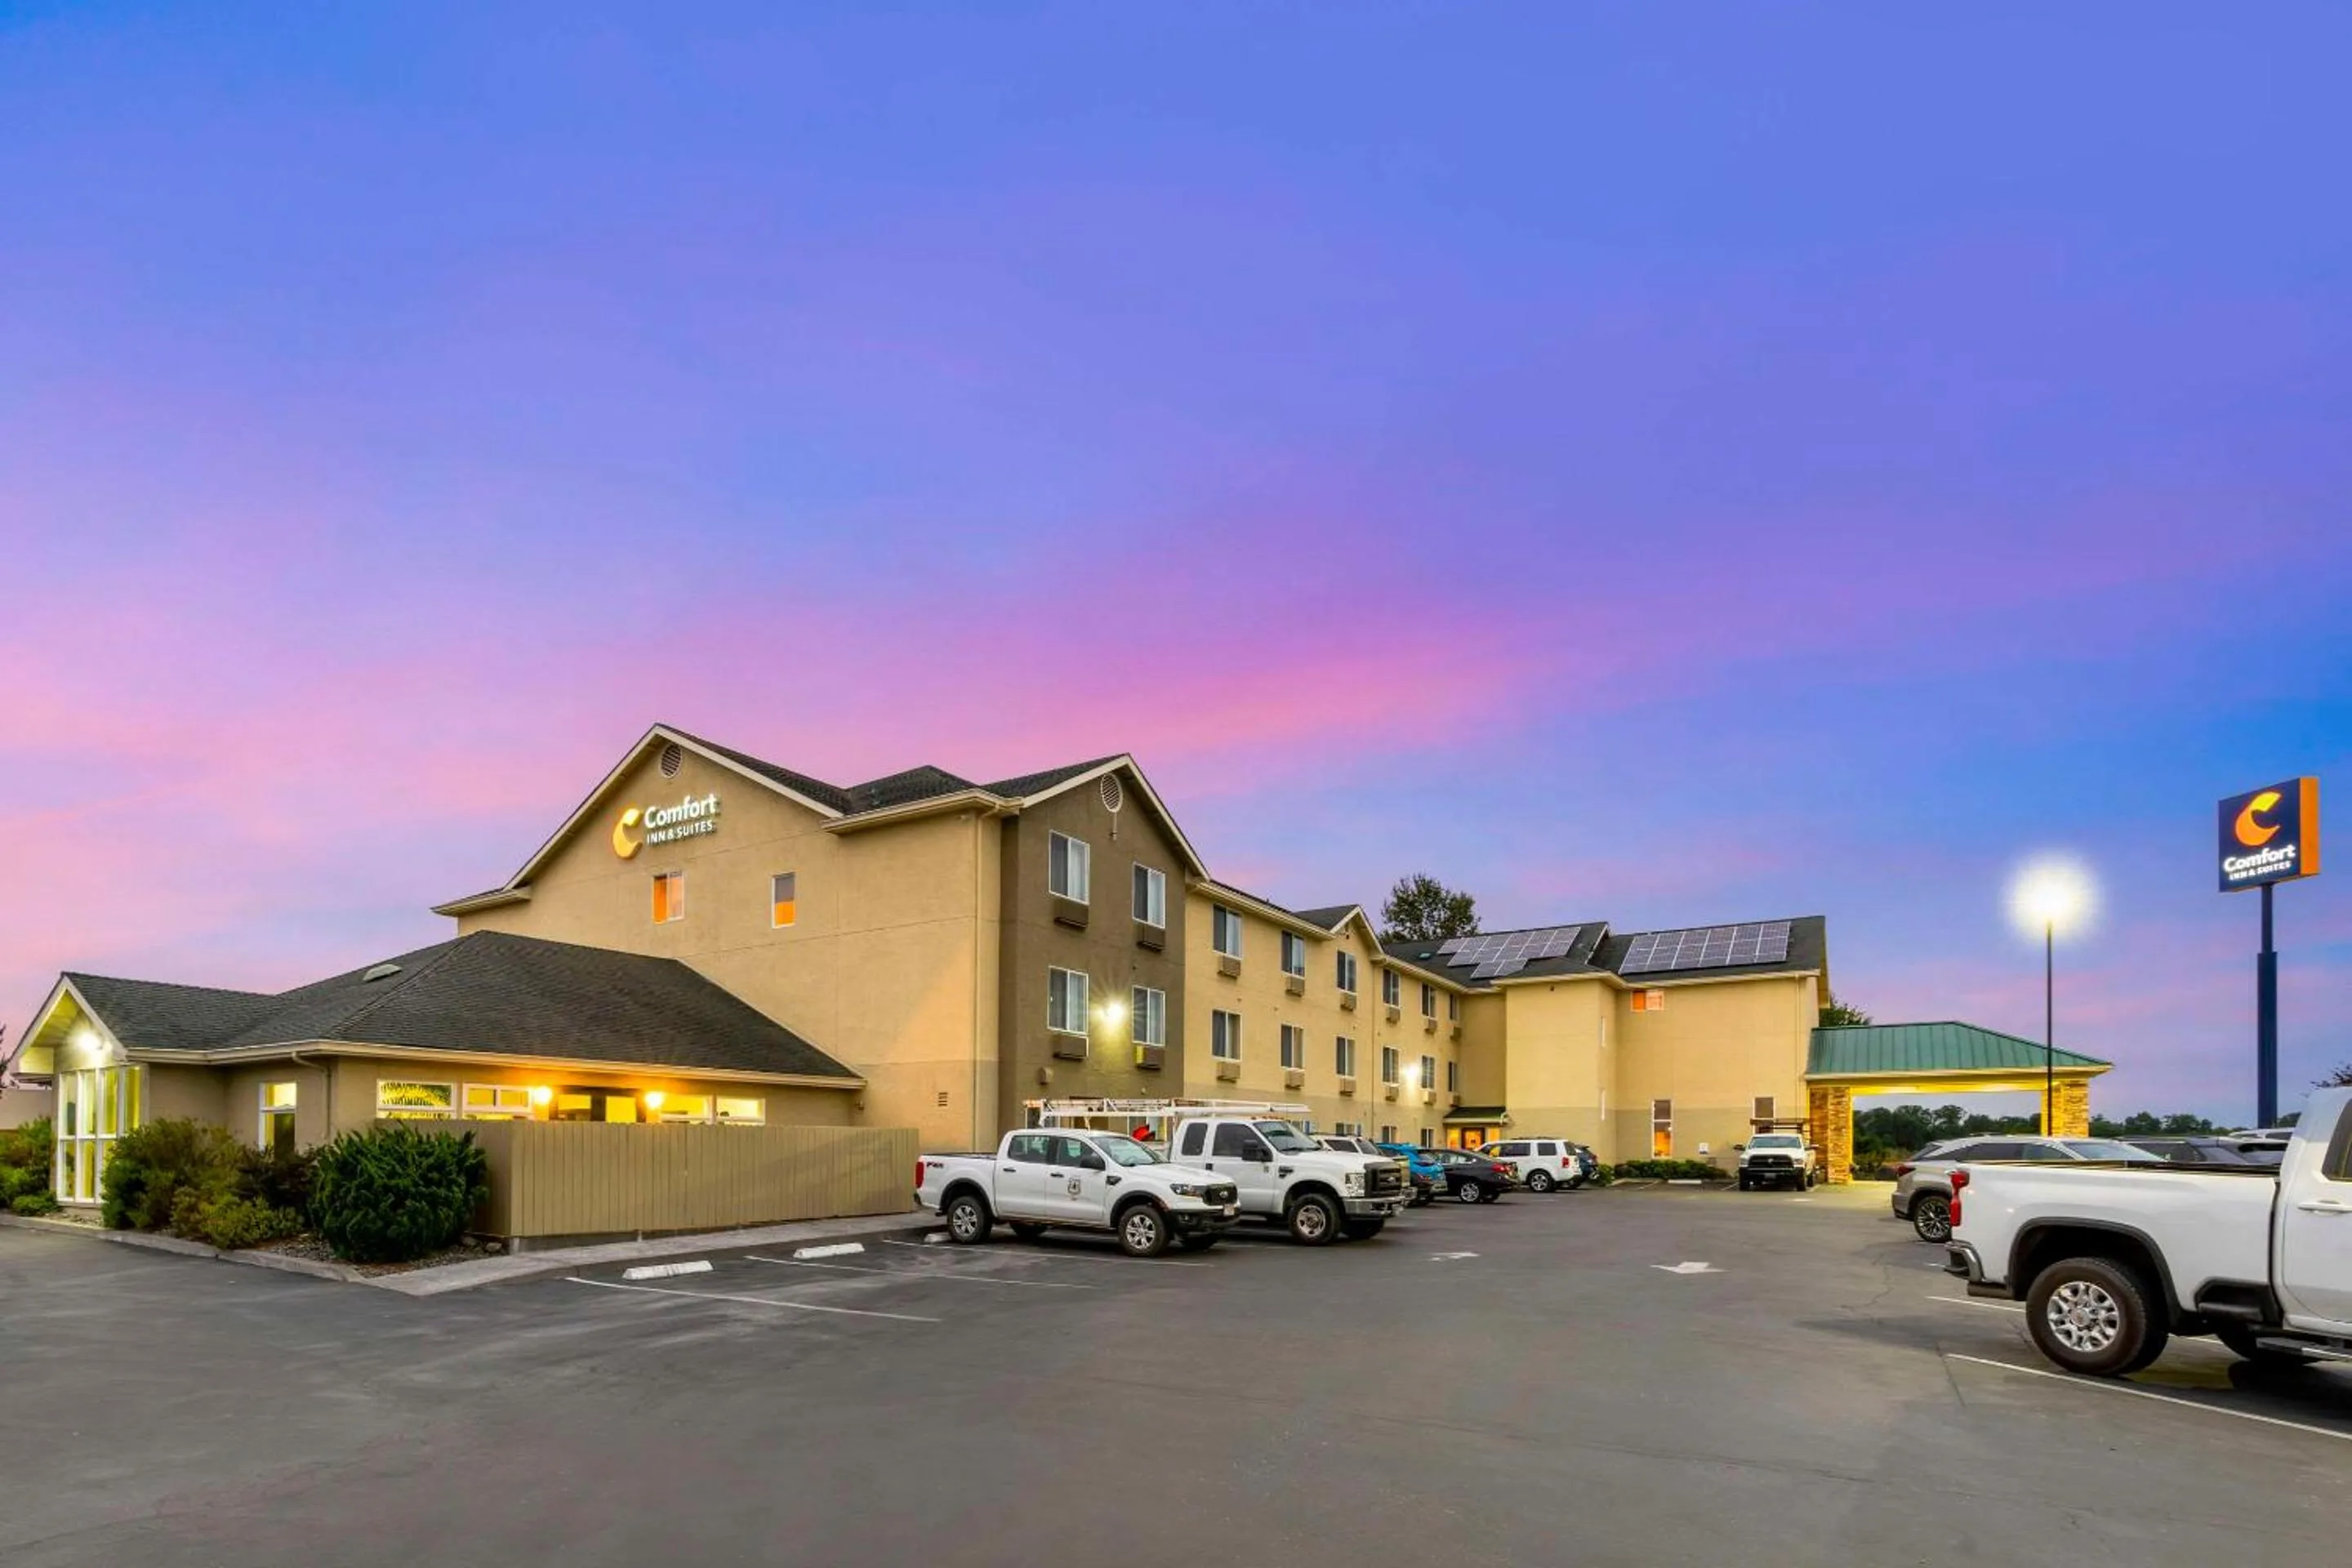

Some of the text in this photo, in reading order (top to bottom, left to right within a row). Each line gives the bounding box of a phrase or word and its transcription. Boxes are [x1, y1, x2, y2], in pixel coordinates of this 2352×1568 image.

[644, 794, 716, 828] Comfort
[647, 820, 713, 844] INN & SUITES
[2223, 844, 2296, 872] Comfort
[2229, 871, 2247, 880] INN
[2257, 861, 2291, 875] SUITES
